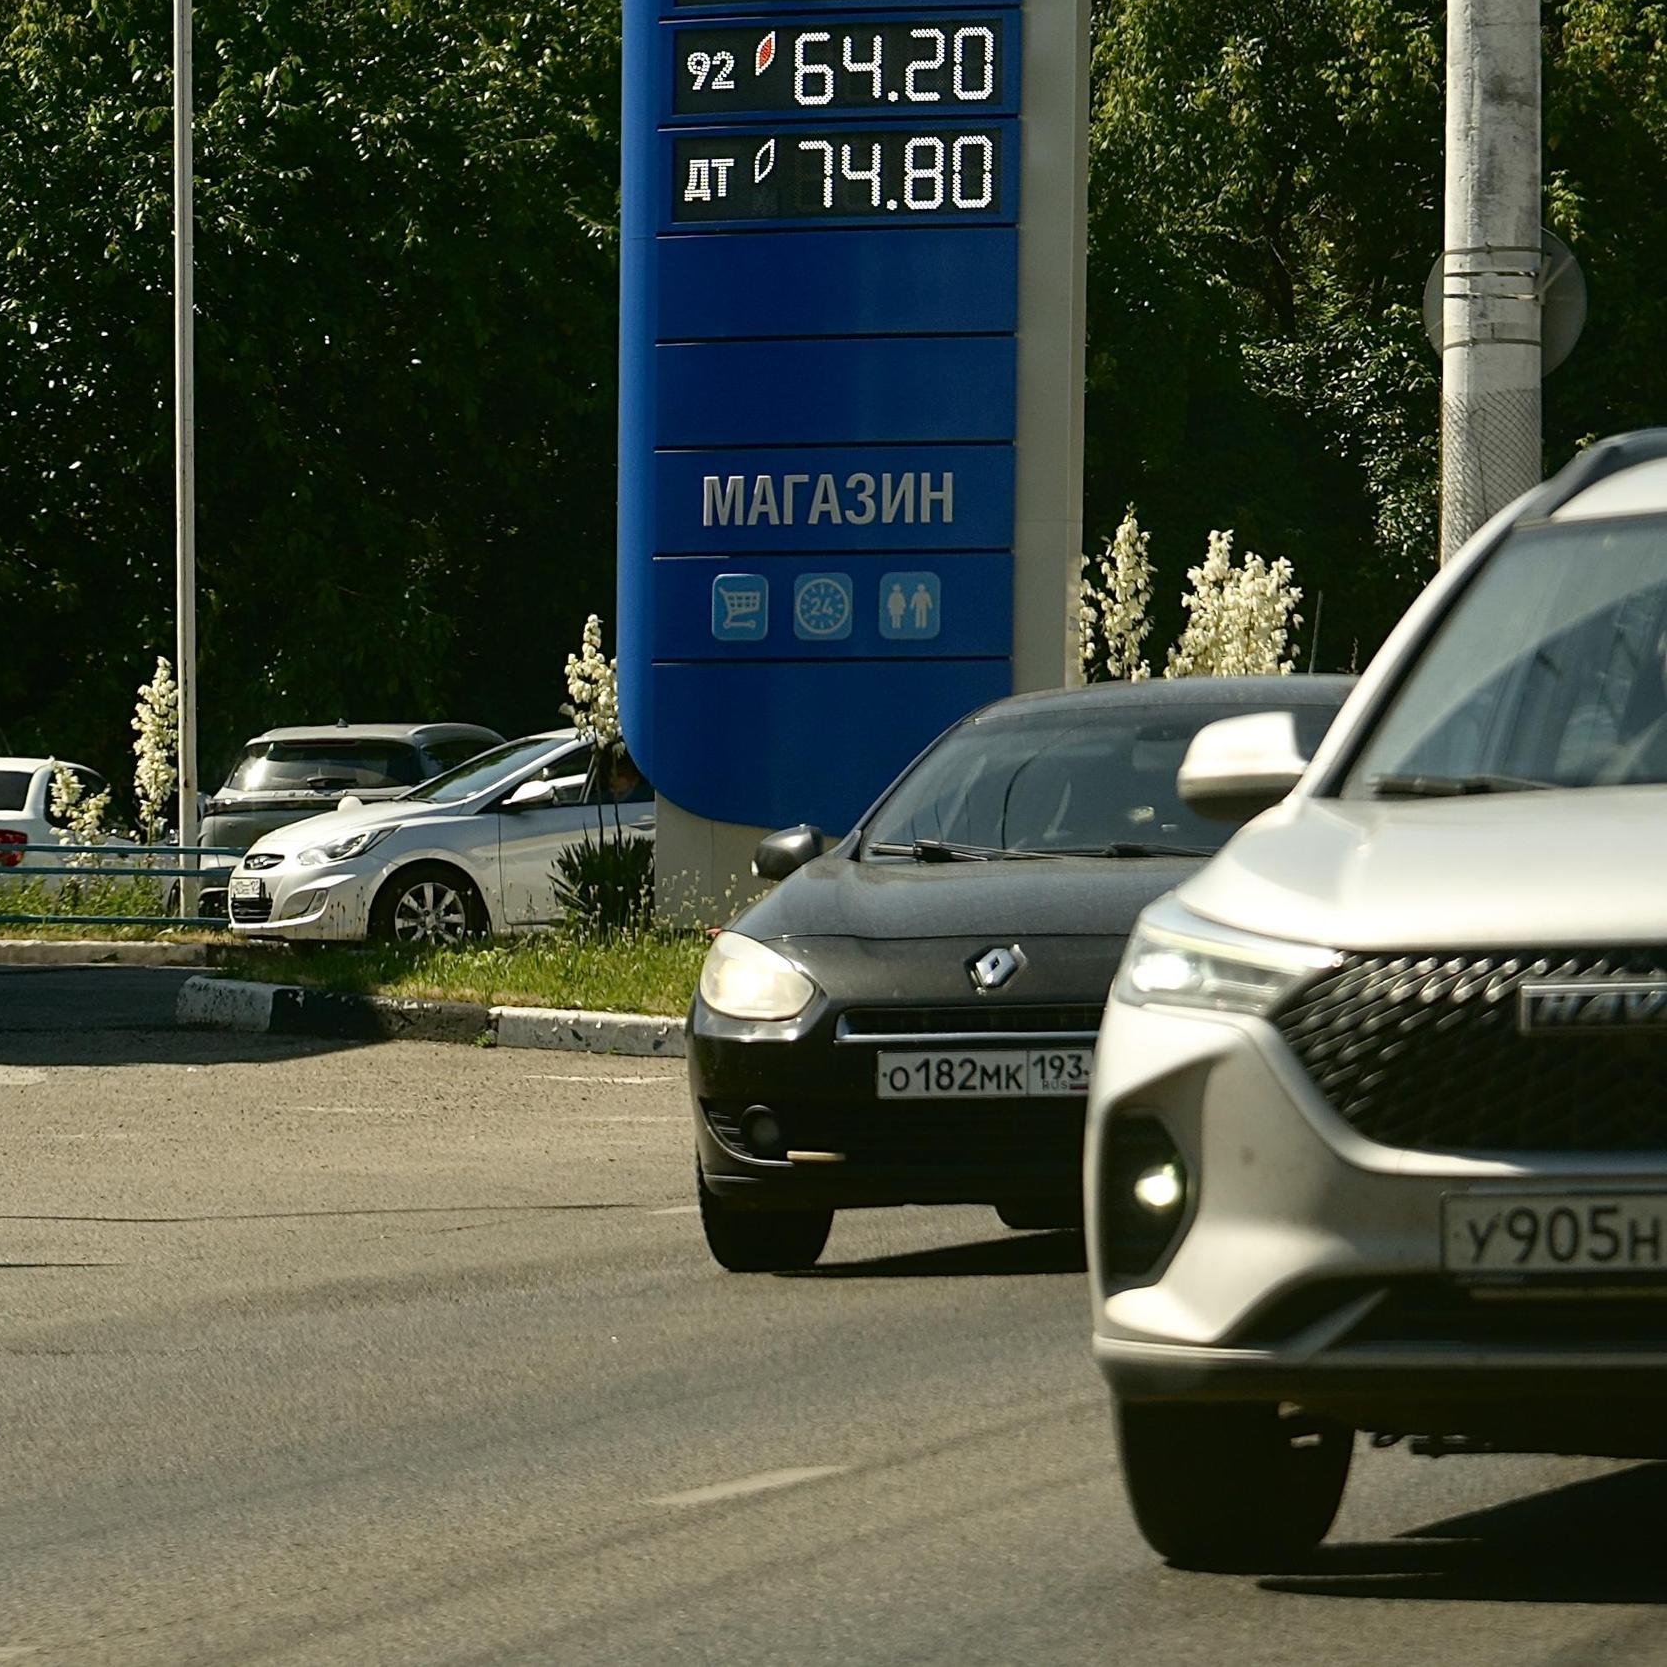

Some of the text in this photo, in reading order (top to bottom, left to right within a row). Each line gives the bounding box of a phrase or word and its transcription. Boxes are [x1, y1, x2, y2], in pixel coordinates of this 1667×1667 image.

[686, 27, 994, 105] 92 64.20
[684, 135, 993, 210] ДТ 74.80
[702, 472, 954, 527] МАГАЗИН
